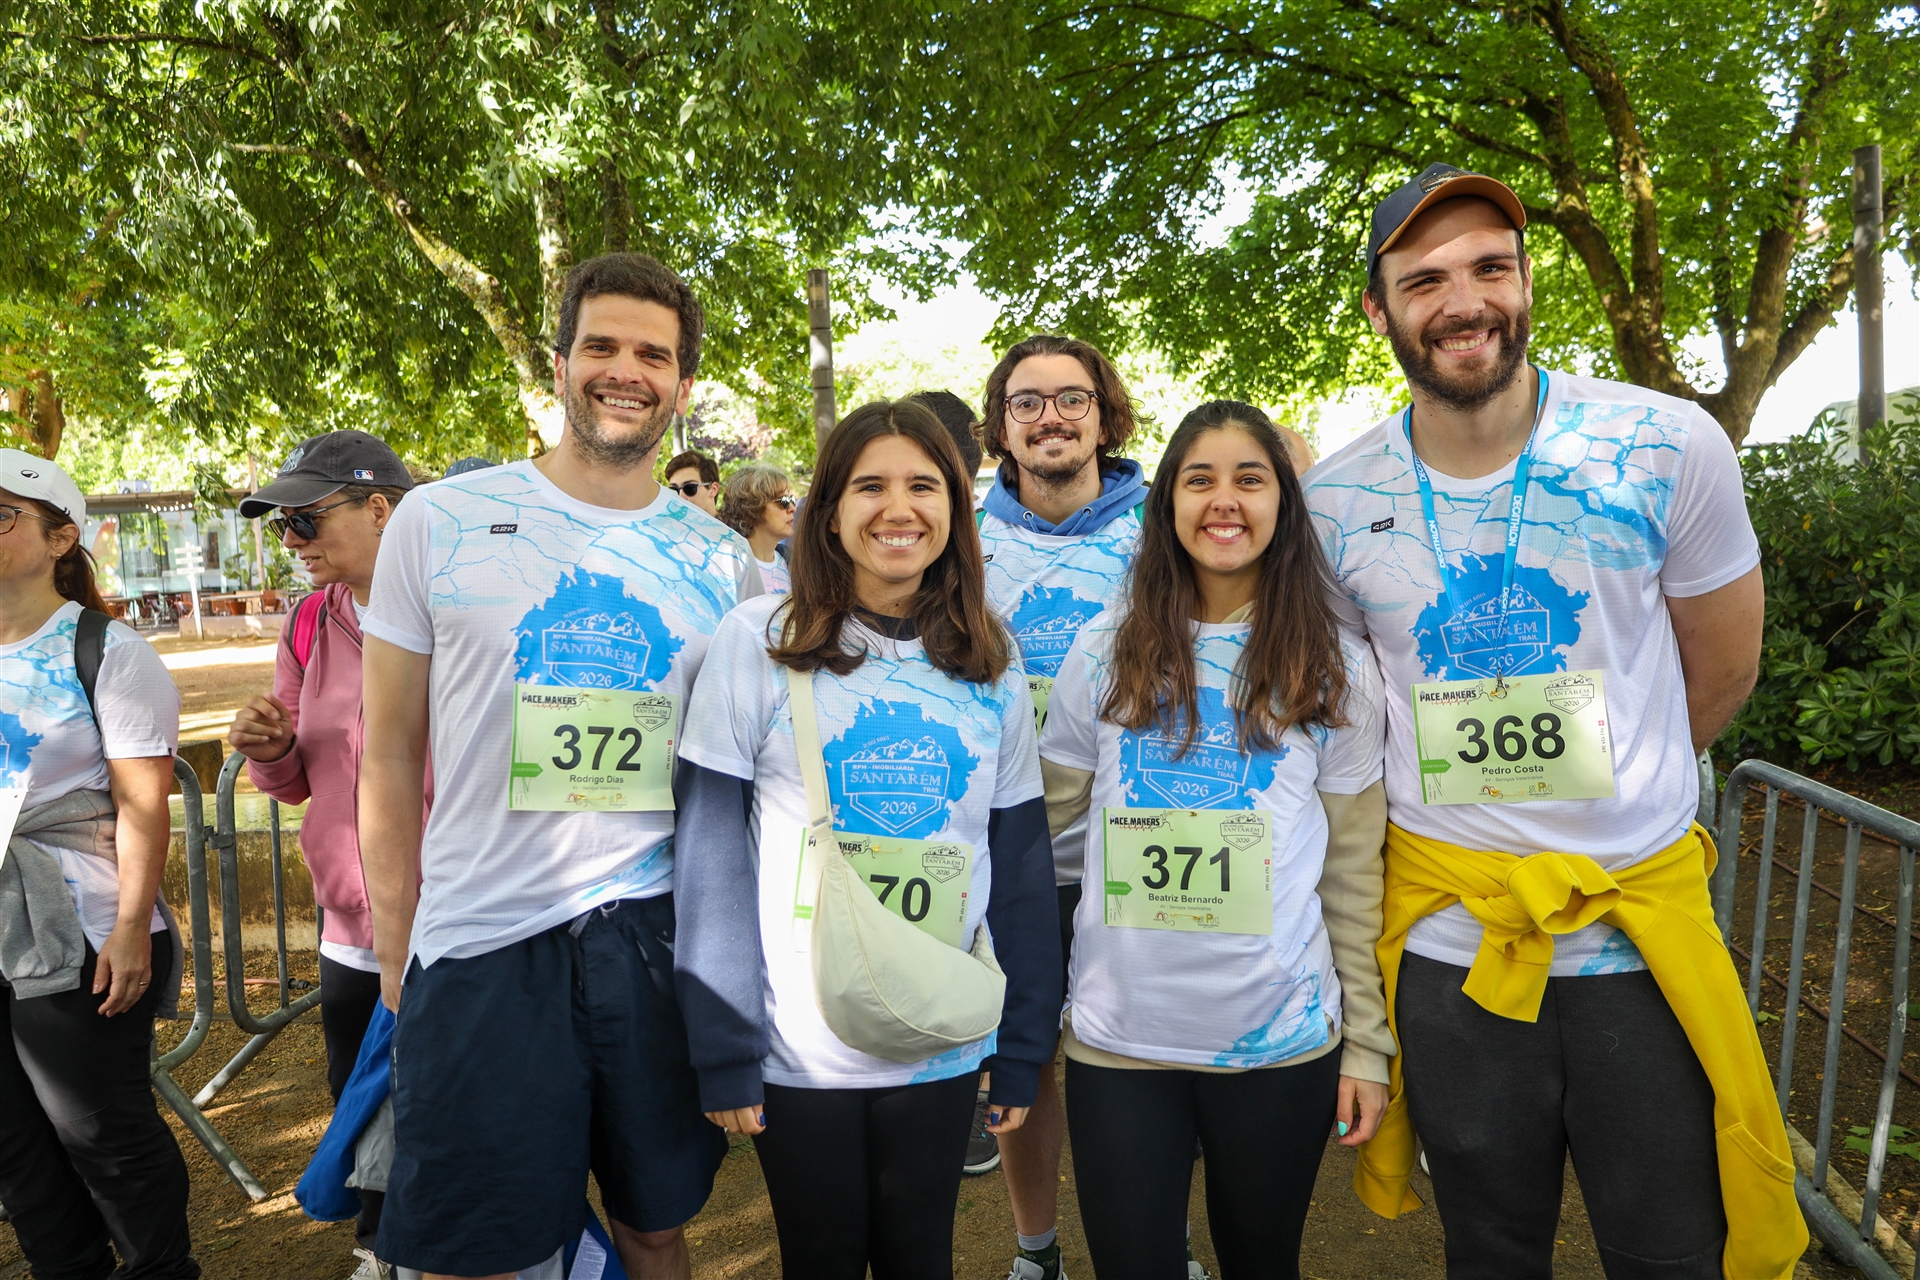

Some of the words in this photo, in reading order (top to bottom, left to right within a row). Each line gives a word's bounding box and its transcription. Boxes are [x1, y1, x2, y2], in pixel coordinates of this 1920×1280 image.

[1372, 519, 1391, 530] 42K
[1508, 494, 1523, 547] DECATHLON
[1427, 519, 1447, 569] DECATHLON
[1019, 640, 1071, 651] SANTAR
[1518, 634, 1538, 642] TRAIL
[550, 640, 637, 663] SANTARÉM
[616, 661, 635, 670] TRAIL
[578, 671, 613, 687] 2026
[1456, 712, 1565, 764] 368
[552, 724, 642, 771] 372
[872, 764, 915, 772] IMOBILIÁRIA
[1216, 770, 1236, 779] TRAIL
[1481, 766, 1511, 775] Pedro
[1514, 764, 1544, 773] Costa
[570, 775, 605, 784] Rodrigo
[606, 775, 624, 784] Dias
[850, 771, 942, 786] SANTARÉM
[923, 786, 940, 794] TRAIL
[1171, 780, 1209, 797] 2026
[879, 800, 917, 815] 2026
[1142, 844, 1231, 892] 371
[858, 874, 932, 922] 70
[1148, 893, 1179, 903] Beatriz
[1181, 895, 1224, 905] Bernardo
